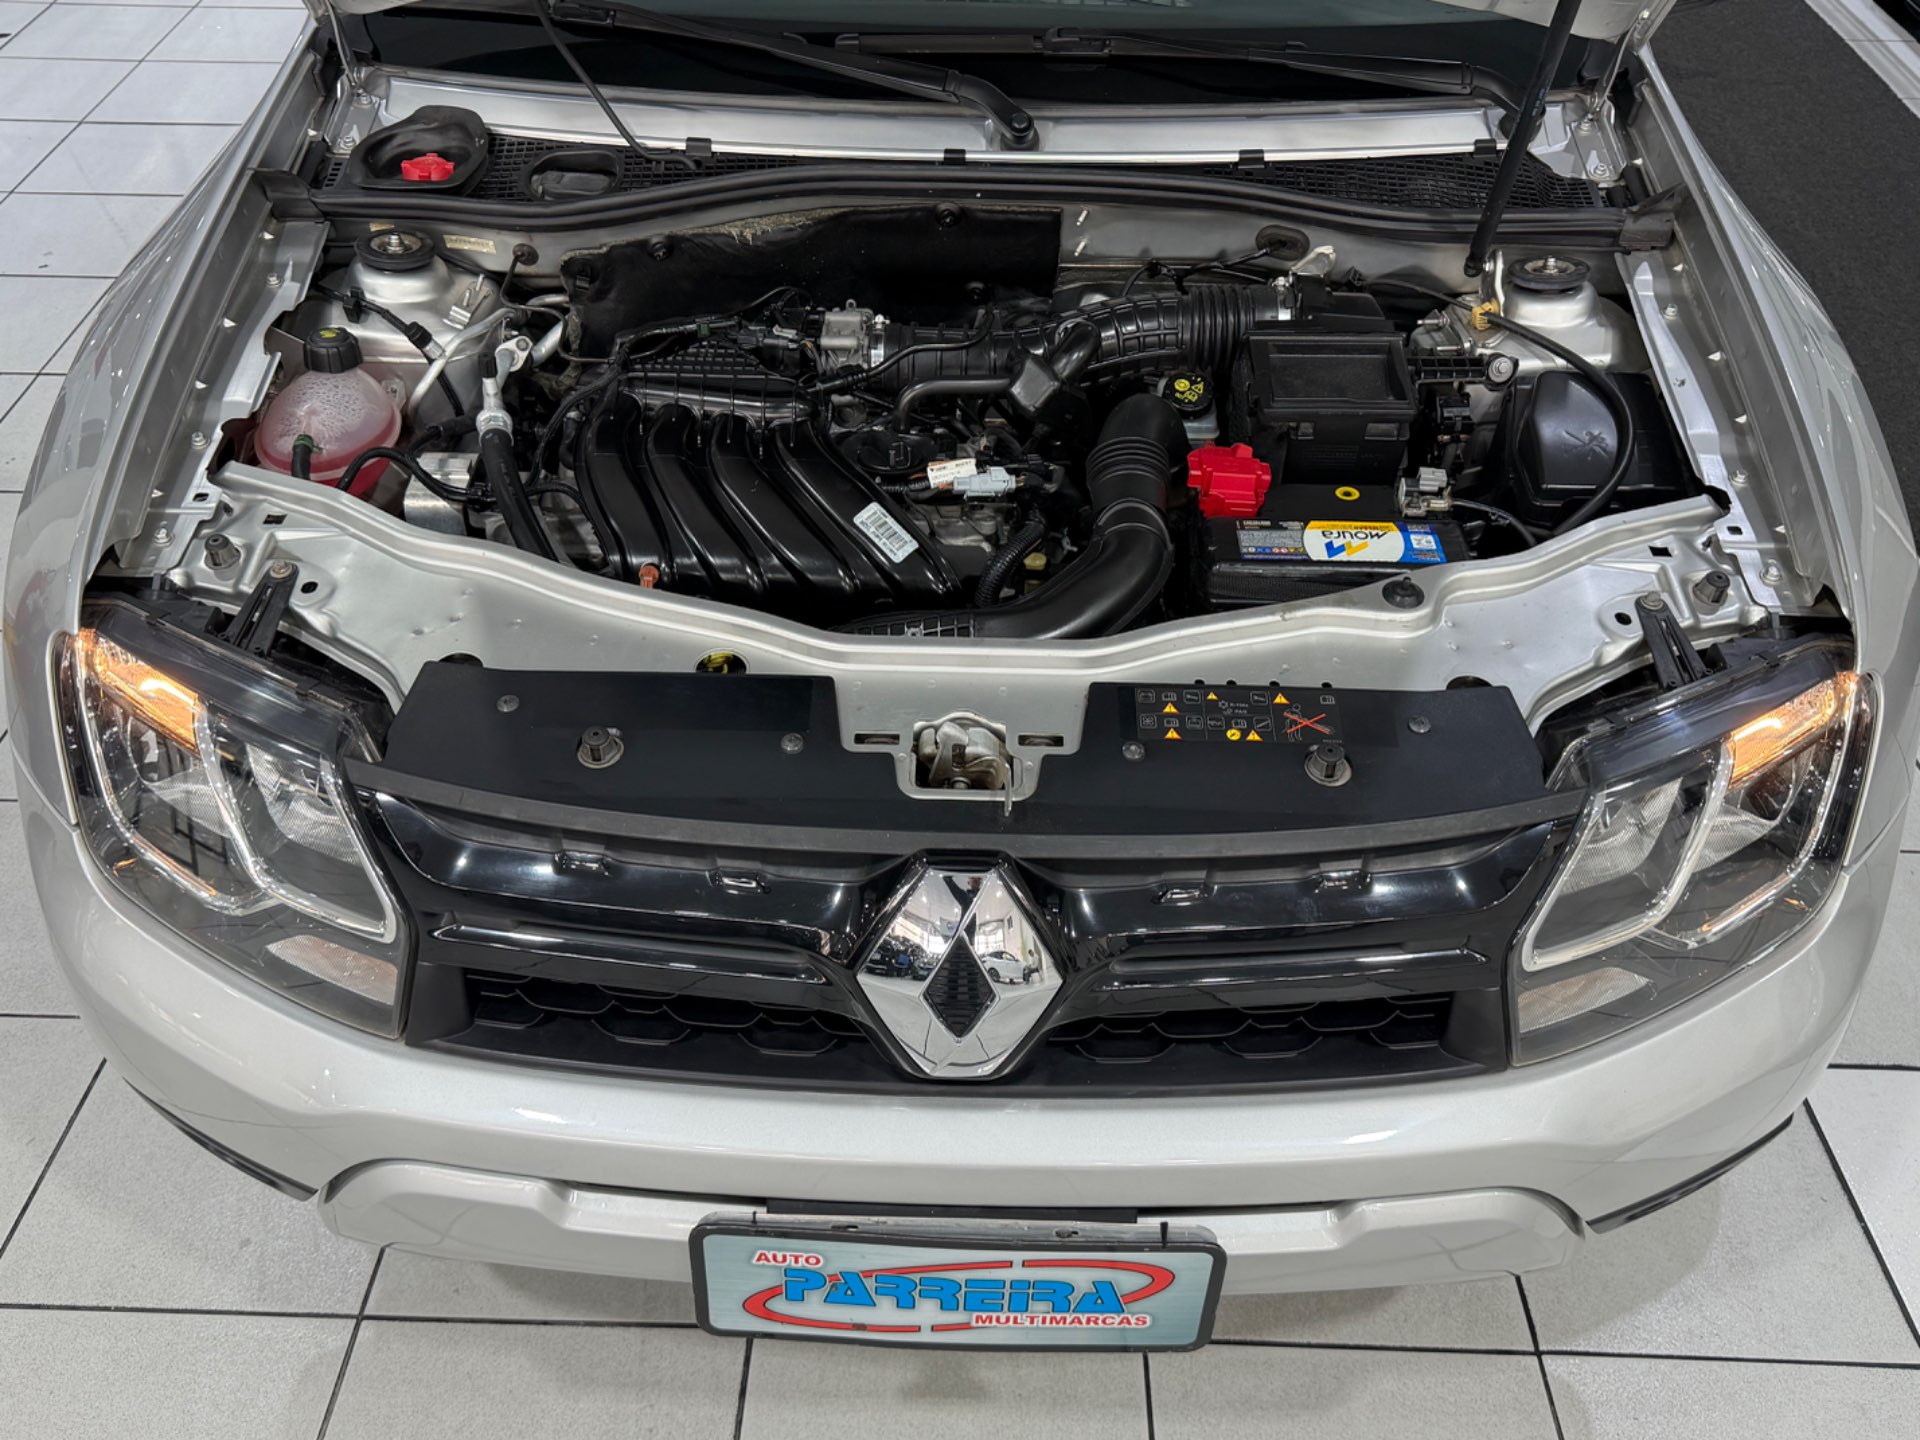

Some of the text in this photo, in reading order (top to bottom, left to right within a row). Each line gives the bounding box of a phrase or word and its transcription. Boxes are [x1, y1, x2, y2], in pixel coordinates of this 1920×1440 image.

[755, 1251, 822, 1266] AUTO
[783, 1268, 1126, 1314] PARREIRA
[974, 1313, 1149, 1327] MULTIMARCAS
